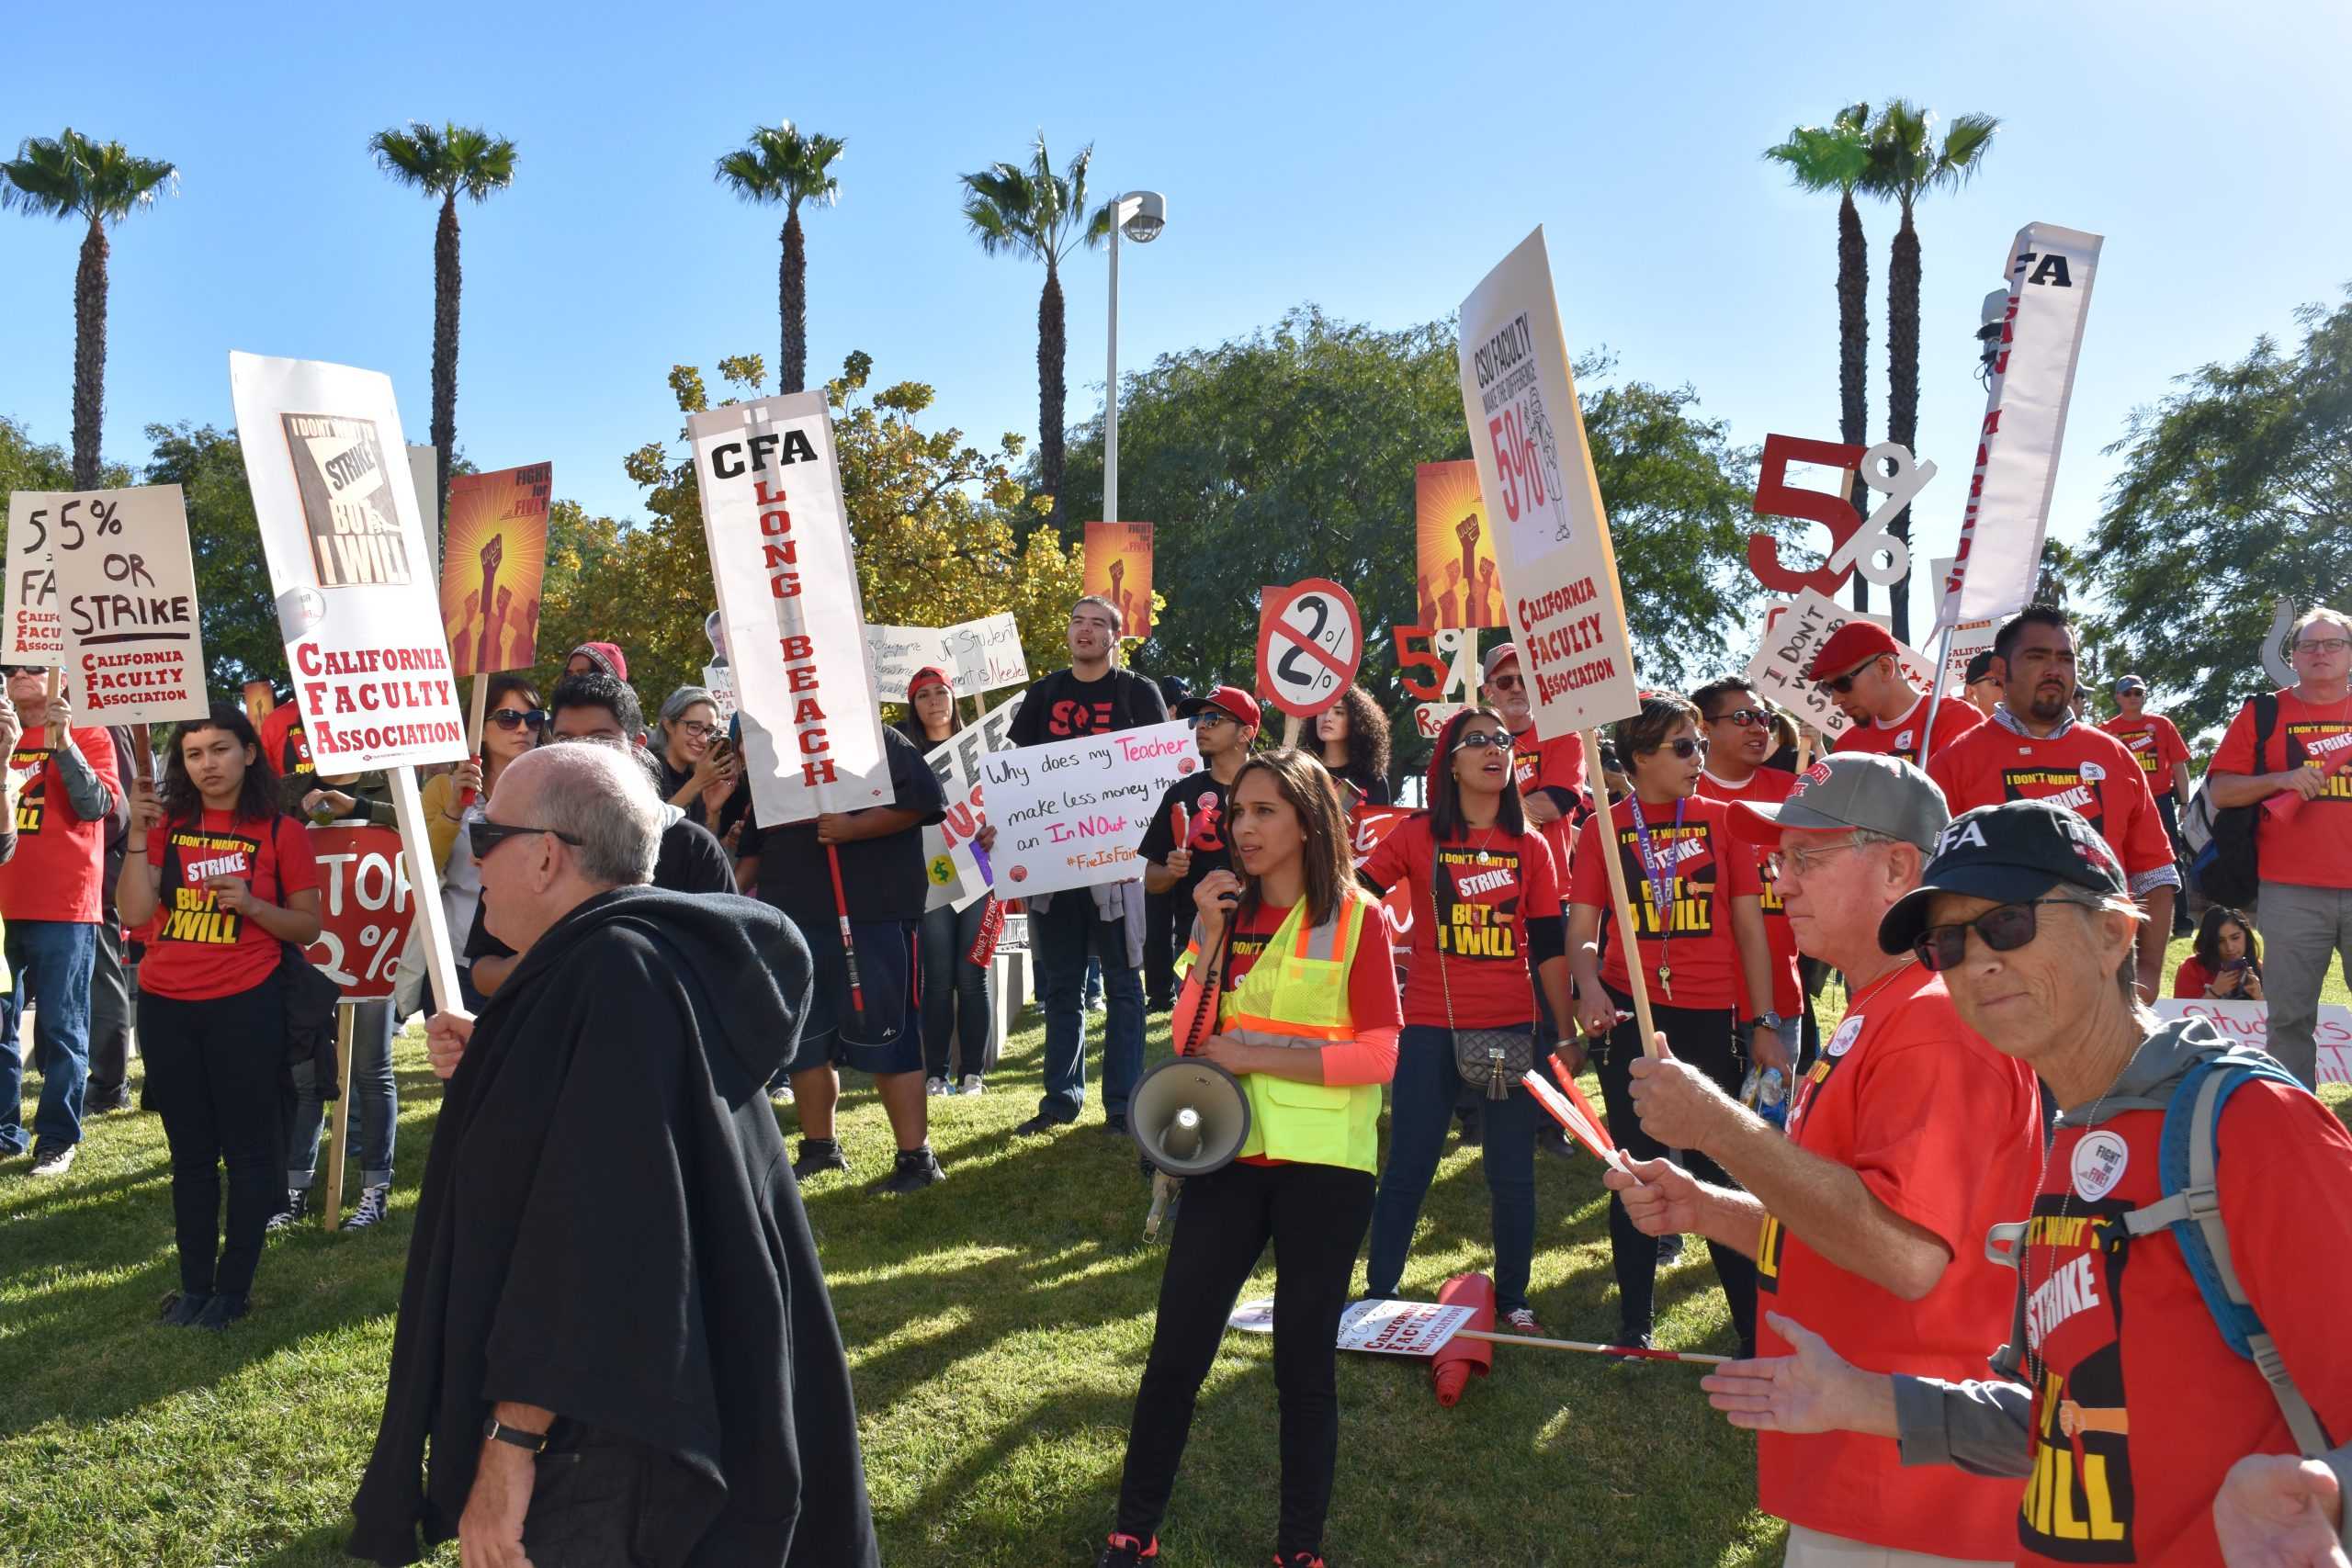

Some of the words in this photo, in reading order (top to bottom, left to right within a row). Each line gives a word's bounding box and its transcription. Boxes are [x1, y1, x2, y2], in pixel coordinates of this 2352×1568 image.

[1475, 344, 1494, 389] CSU
[1490, 310, 1532, 378] FACULTY
[291, 418, 300, 436] I
[325, 440, 376, 491] STRIKE
[711, 429, 819, 479] CFA
[1488, 401, 1544, 523] 5%
[61, 500, 122, 550] 5%
[328, 498, 378, 535] BUT
[1749, 433, 1938, 597] 5%
[753, 480, 801, 599] LONG
[103, 553, 155, 588] OR
[317, 535, 338, 585] I
[333, 535, 412, 585] WILL
[70, 595, 191, 636] STRIKE
[1519, 576, 1598, 633] CALIFORNIA
[82, 649, 185, 671] CALIFORNIA
[297, 643, 447, 677] CALIFORNIA
[1278, 595, 1346, 691] 2%
[1526, 613, 1603, 671] FACULTY
[1763, 666, 1788, 688] I
[1777, 604, 1824, 663] DON'T
[85, 668, 184, 691] FACULTY
[1393, 626, 1484, 700] 5%
[1534, 657, 1615, 706] ASSOCIATION
[87, 689, 187, 710] ASSOCIATION
[304, 680, 449, 716] FACULTY
[780, 635, 838, 787] BEACH
[314, 721, 459, 754] ASSOCIATION
[2293, 726, 2319, 734] DON'T
[2321, 725, 2345, 733] WANT
[986, 760, 1030, 786] Why
[1042, 754, 1080, 773] does
[1089, 749, 1112, 770] my
[1114, 737, 1189, 762] Teacher
[2006, 774, 2011, 784] I
[2013, 773, 2045, 784] DON'T
[2047, 774, 2077, 784] WANT
[1008, 799, 1058, 826] make
[1063, 792, 1097, 809] less
[1102, 784, 1148, 801] money
[1154, 776, 1183, 791] tha
[172, 834, 178, 844] I
[178, 835, 209, 849] DON'T
[211, 839, 241, 851] WANT
[242, 841, 255, 853] TO
[1017, 837, 1039, 851] an
[1622, 834, 1625, 844] I
[1694, 827, 1707, 837] TO
[187, 852, 246, 882] STRIKE
[1440, 853, 1443, 863] I
[1445, 853, 1474, 864] DON'T
[1505, 858, 1519, 868] TO
[176, 887, 218, 912] BUT
[316, 852, 413, 917] TOP
[1458, 868, 1515, 897] STRIKE
[1641, 877, 1683, 901] BT
[172, 909, 237, 944] WILL
[1452, 904, 1491, 925] BUT
[305, 925, 401, 987] 2%
[1440, 924, 1448, 948] I
[1453, 926, 1515, 956] WILL
[2096, 1145, 2120, 1165] FIGHT
[2045, 1216, 2088, 1247] WANT
[2028, 1252, 2100, 1349] STRIKE
[1363, 1303, 1423, 1349] CALIFORNIA
[1385, 1305, 1442, 1350] FACULTY
[1405, 1306, 1464, 1353] ASSOCIATION
